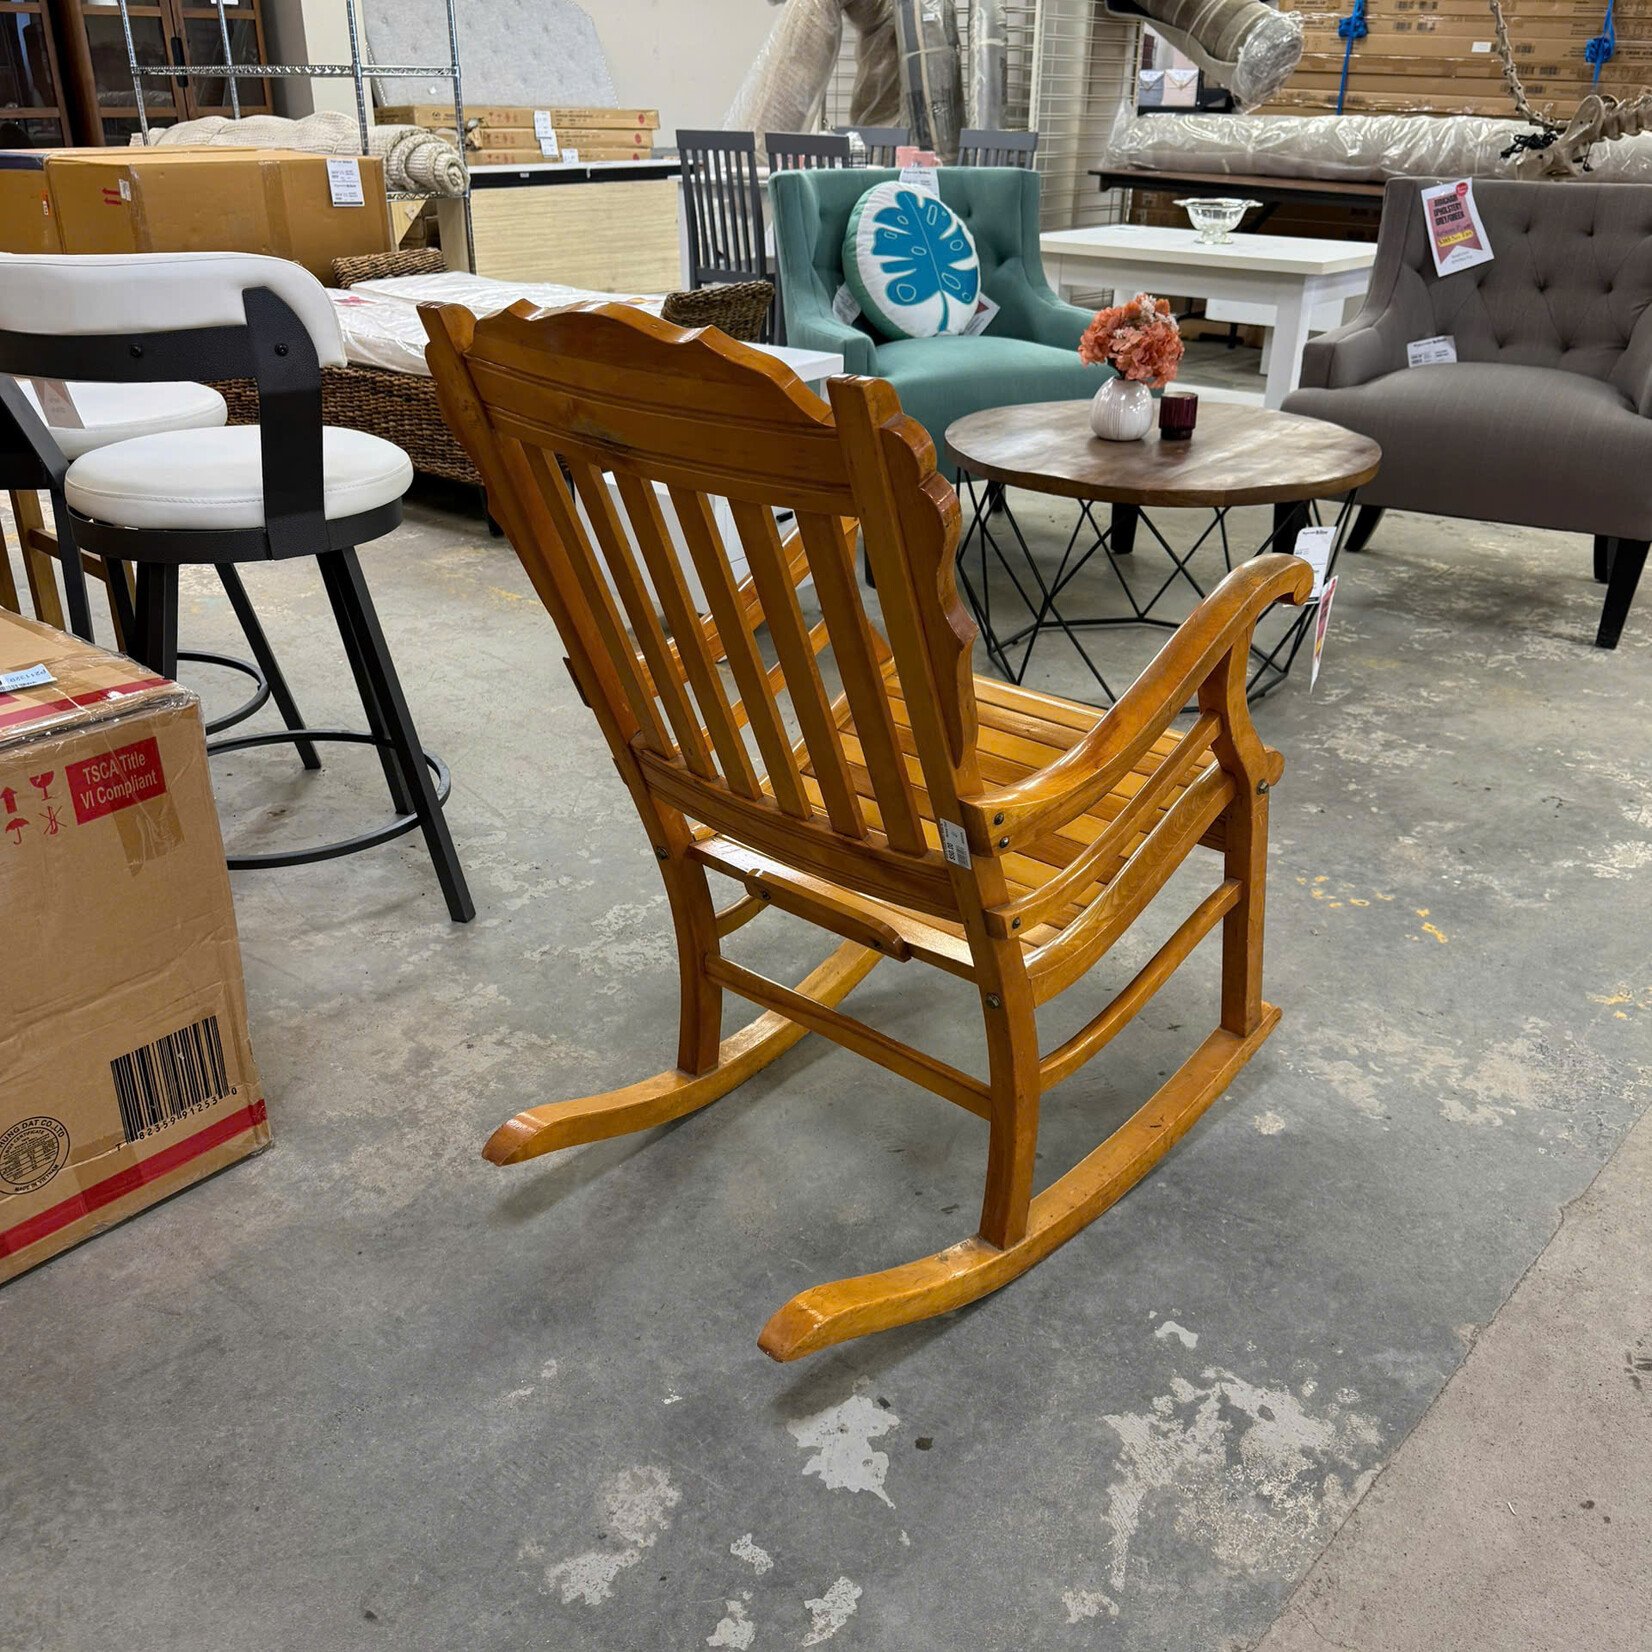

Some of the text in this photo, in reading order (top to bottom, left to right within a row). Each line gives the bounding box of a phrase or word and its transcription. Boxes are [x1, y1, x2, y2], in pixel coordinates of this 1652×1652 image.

[82, 751, 146, 785] TSCA Title
[80, 769, 158, 809] VI Compliant
[22, 1119, 39, 1129] DAT
[138, 1116, 176, 1140] 82359
[181, 1096, 218, 1119] 91253
[230, 1087, 237, 1095] 0
[38, 1164, 59, 1184] VIETNAM
